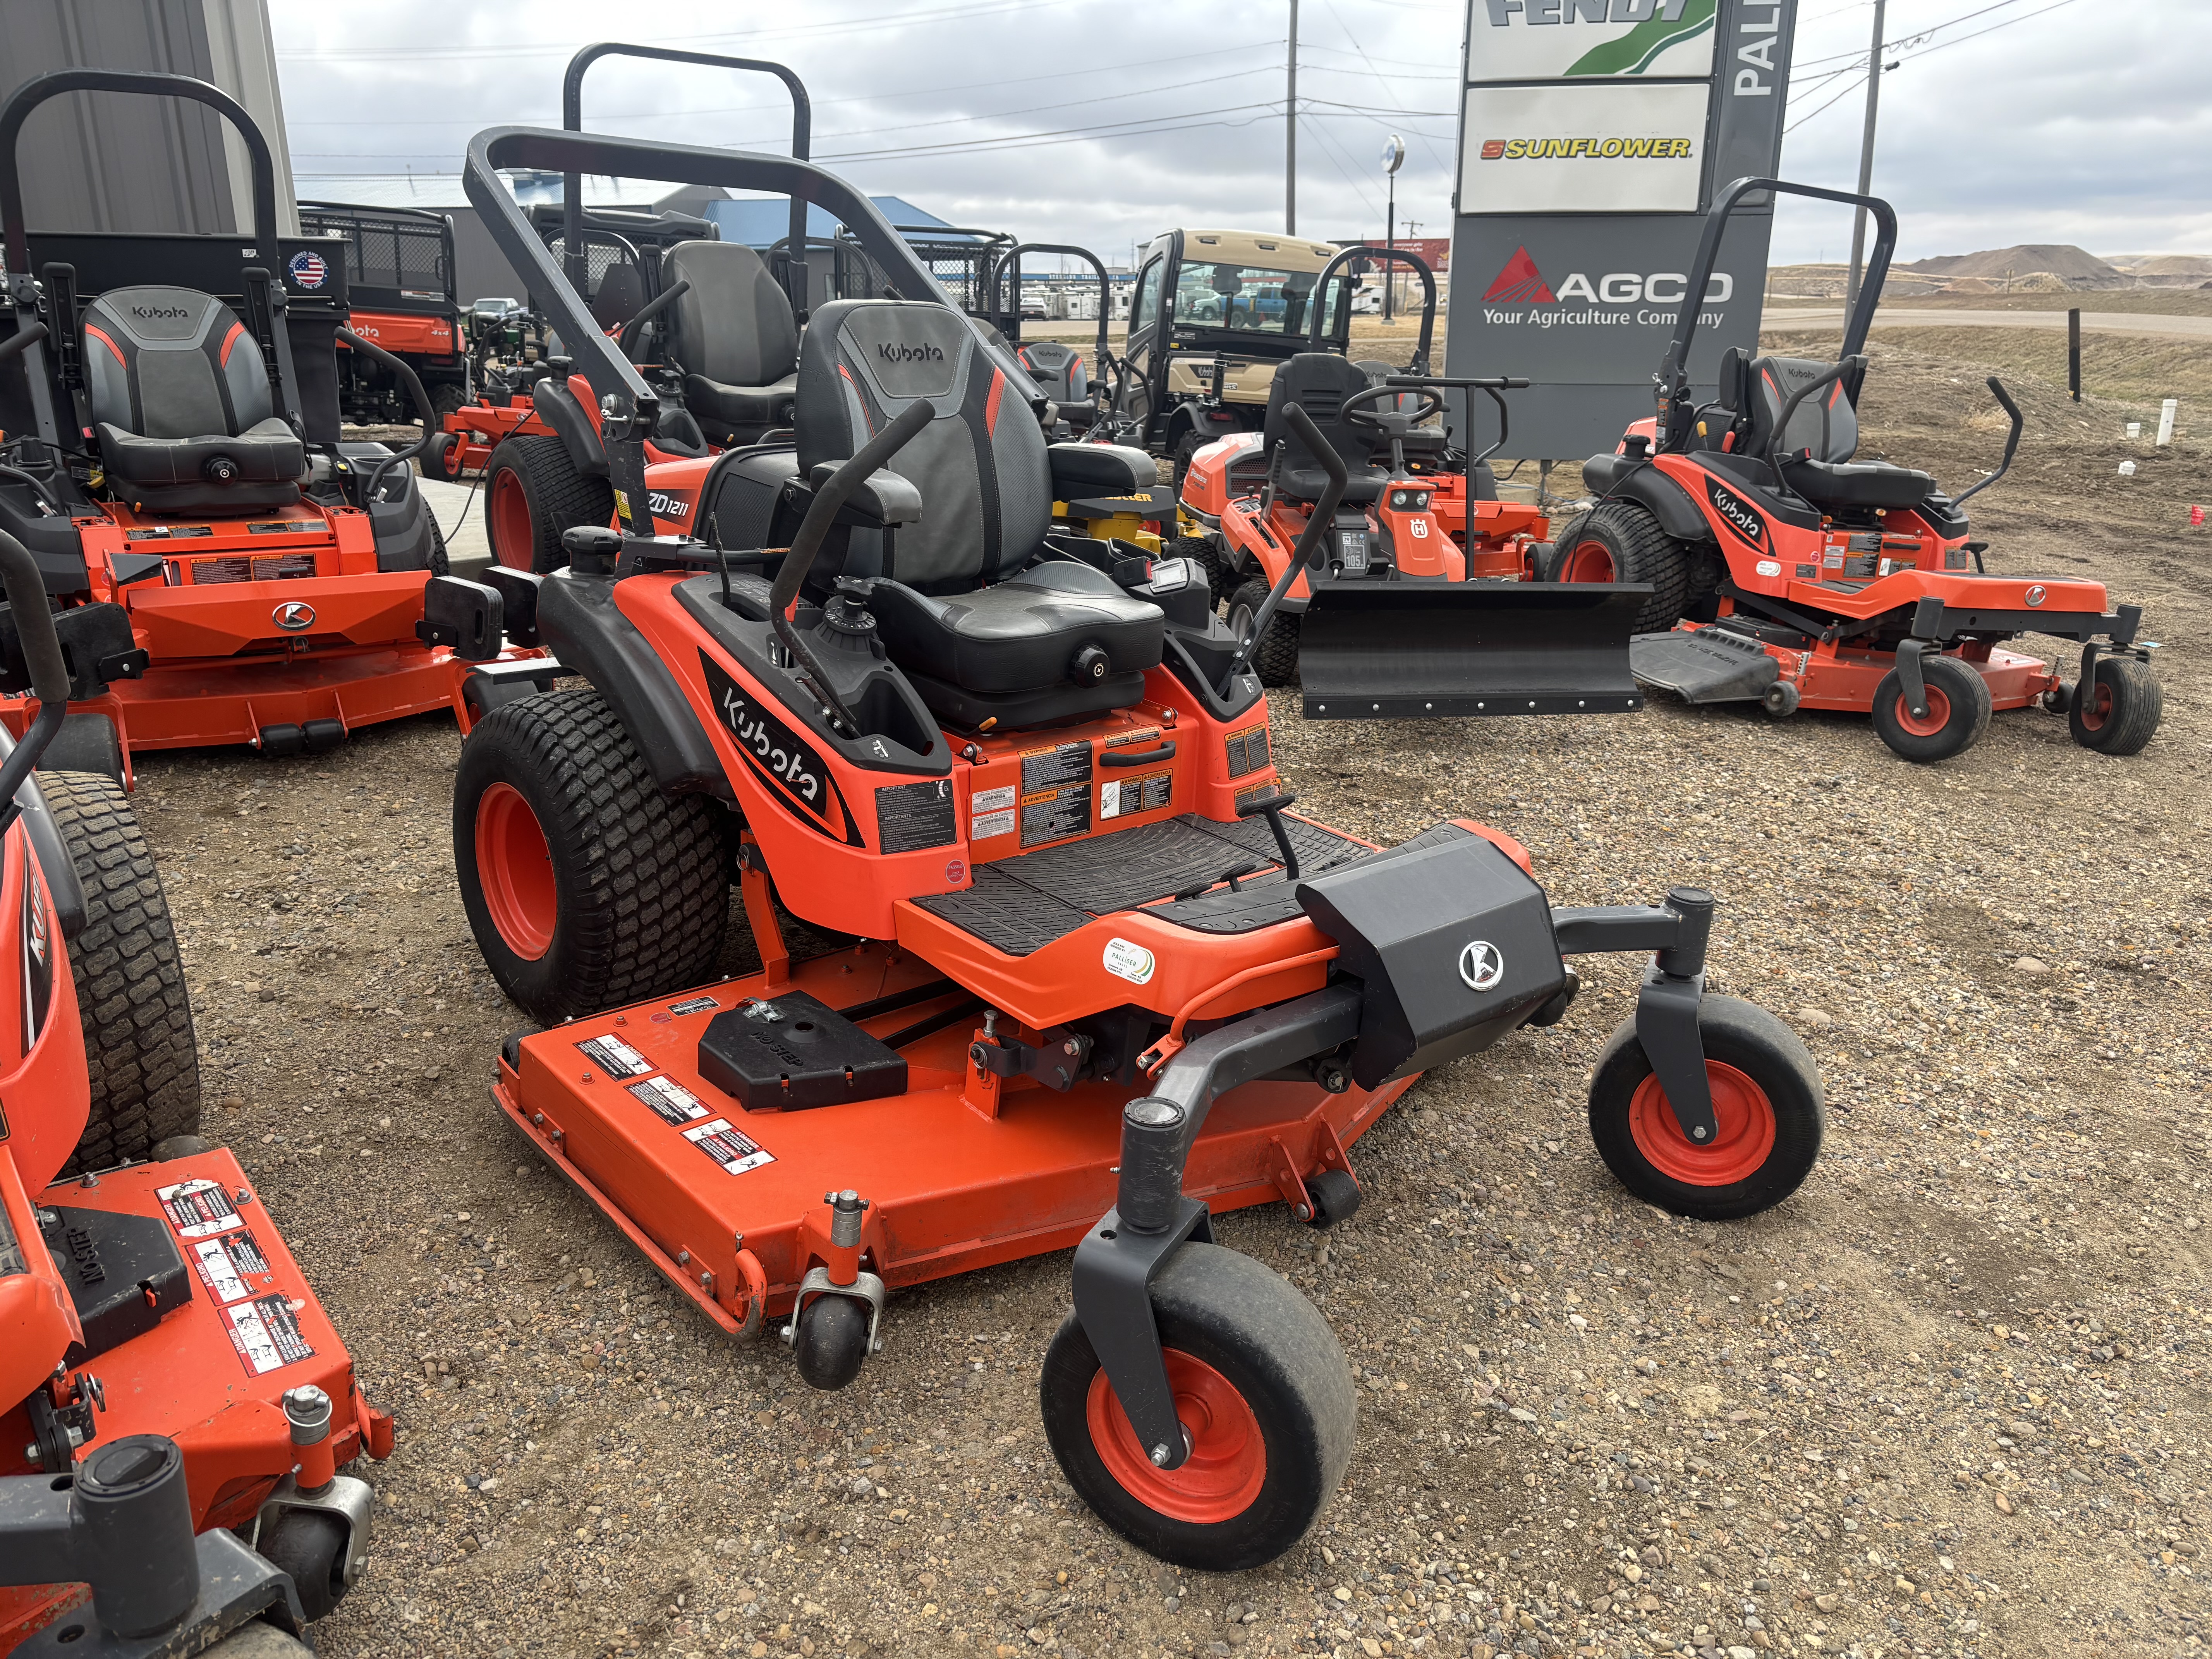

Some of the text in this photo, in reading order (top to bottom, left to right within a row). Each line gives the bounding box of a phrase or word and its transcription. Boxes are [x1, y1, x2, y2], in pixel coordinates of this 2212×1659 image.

[1734, 0, 1781, 96] PAL
[1504, 138, 1691, 158] SUNFLOWER
[289, 251, 307, 268] DESIGNED
[318, 256, 328, 269] BUILT
[1556, 273, 1733, 303] AGCO
[132, 306, 188, 318] Kubota
[1483, 309, 1724, 329] Your Agriculture Comny
[878, 343, 944, 362] Kubota
[1788, 368, 1815, 379] Kubota
[1714, 489, 1758, 536] Kubota
[1346, 555, 1360, 567] 105
[723, 687, 818, 801] Kubota
[1147, 770, 1171, 778] ADVERTENCIA
[1028, 793, 1054, 802] ADVERTENCIA
[30, 860, 45, 967] KUB
[1112, 952, 1137, 967] PALLISER
[627, 1046, 645, 1058] DANGER
[751, 1031, 804, 1067] NO STEP
[680, 1087, 701, 1101] PELIGRO
[715, 1140, 738, 1156] PELIGRO
[738, 1134, 760, 1148] DANGER
[163, 1203, 180, 1221] DANGER
[193, 1195, 211, 1214] PELIGRO
[67, 1228, 105, 1285] NO STEP
[195, 1262, 211, 1283] PELIGRO
[228, 1328, 245, 1350] DANGER
